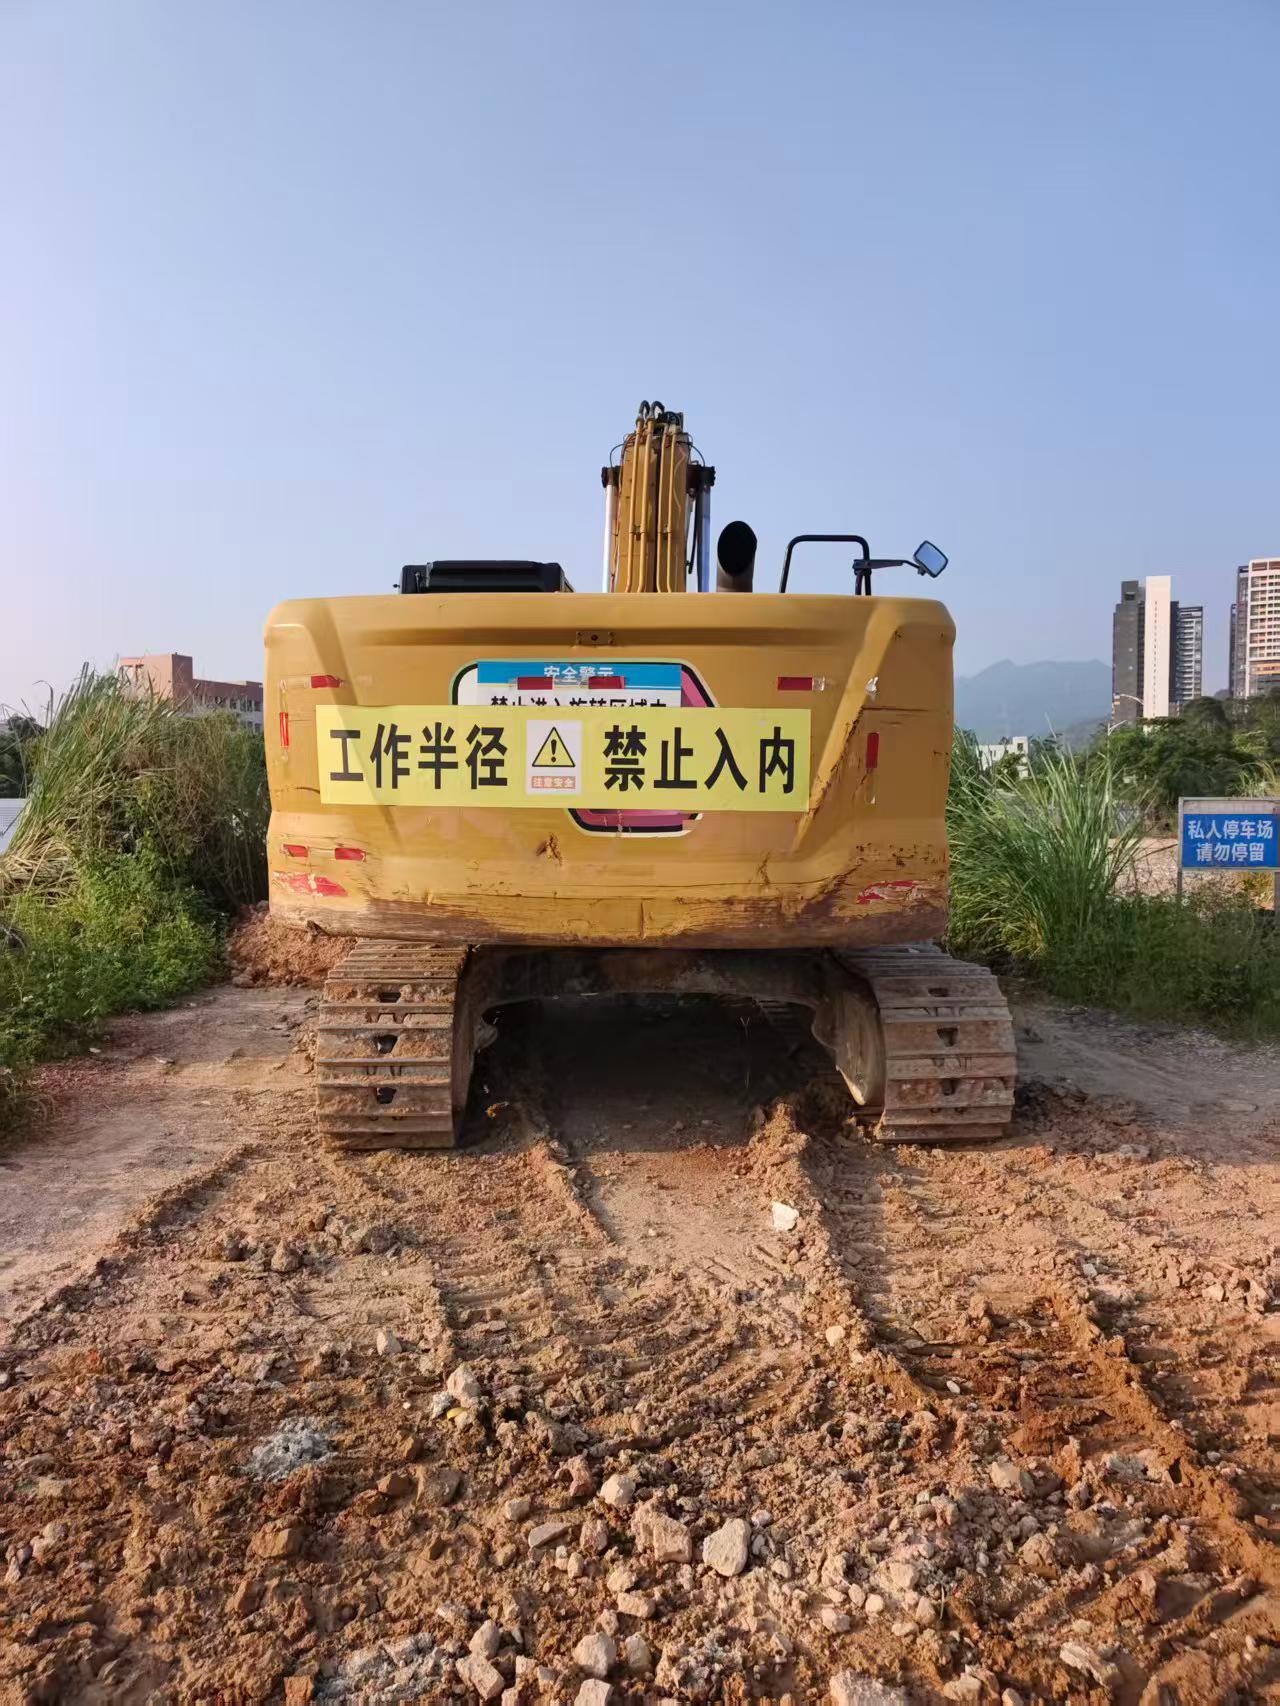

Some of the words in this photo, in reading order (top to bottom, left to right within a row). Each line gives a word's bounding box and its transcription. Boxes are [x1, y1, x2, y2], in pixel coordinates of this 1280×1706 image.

[329, 721, 509, 790] 工作半径
[602, 724, 795, 794] 禁止入内
[1187, 819, 1274, 840] 私人停车场
[1195, 841, 1265, 862] 请勿停留
